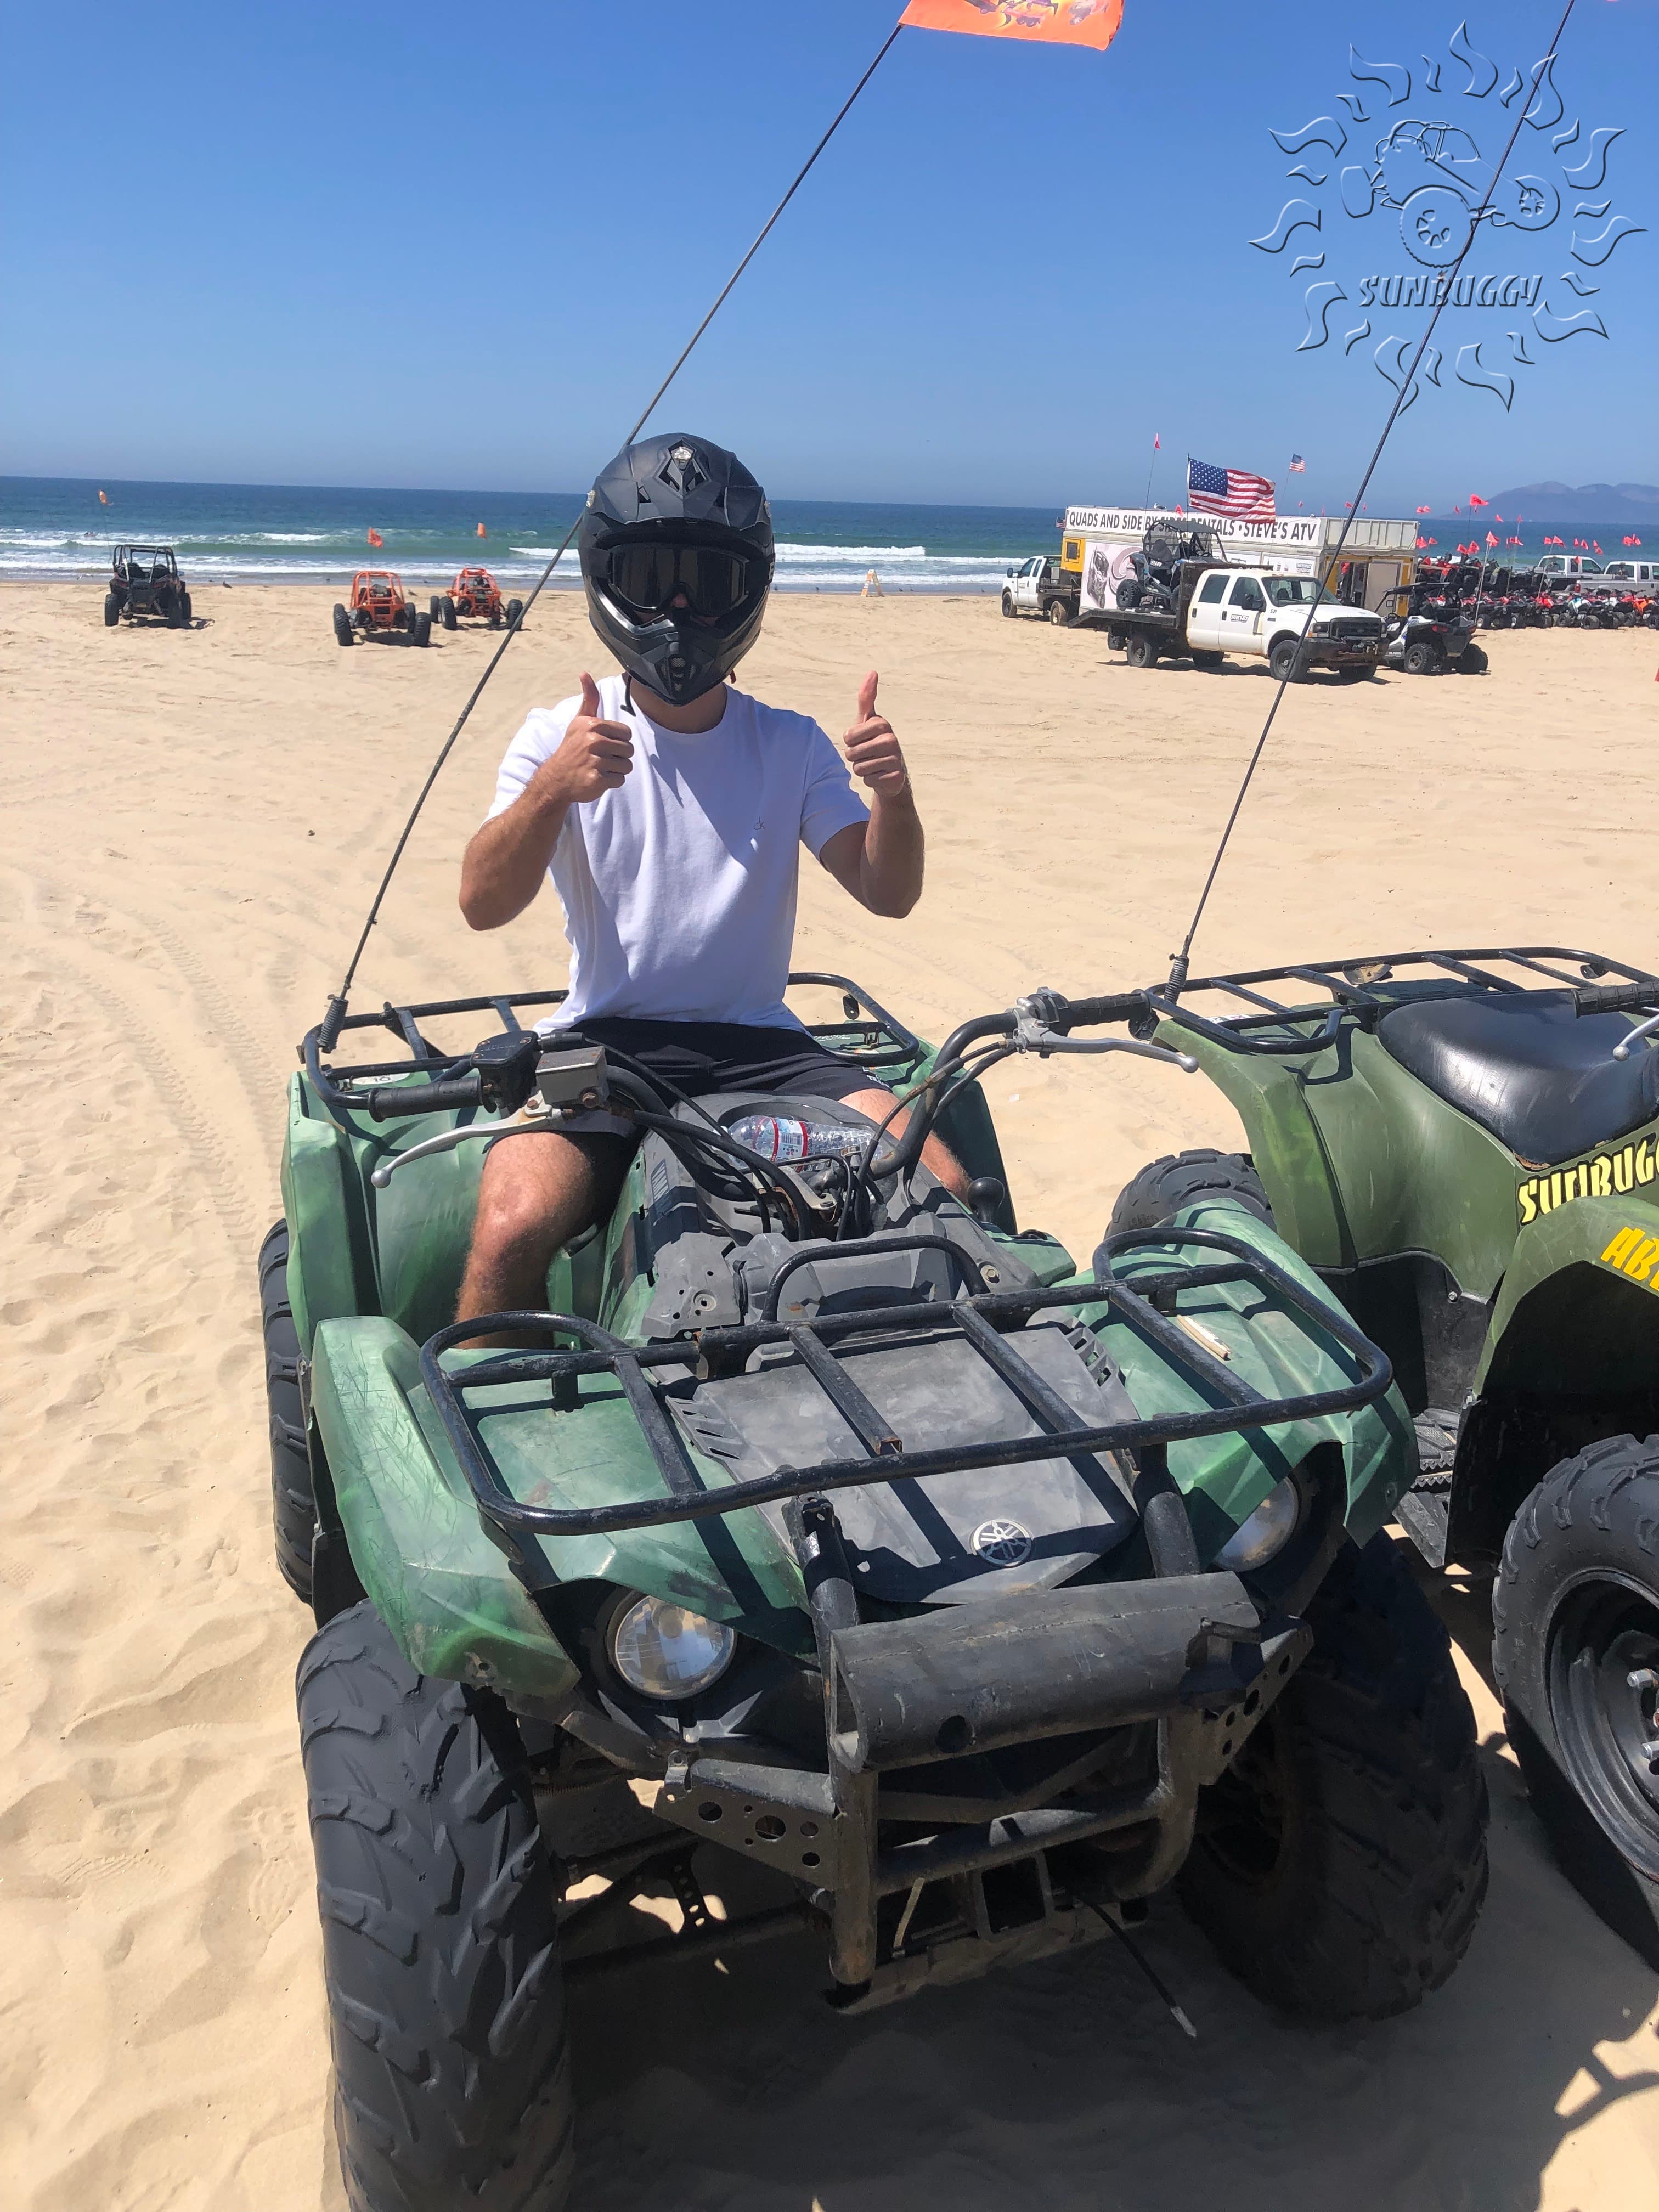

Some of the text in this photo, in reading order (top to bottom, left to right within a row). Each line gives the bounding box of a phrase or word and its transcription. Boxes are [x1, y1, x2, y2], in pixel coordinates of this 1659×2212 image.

[1070, 511, 1099, 527] QUADS
[1100, 514, 1119, 528] AND
[1121, 515, 1143, 530] SIDE
[1145, 516, 1159, 531] BY
[1243, 521, 1288, 539] STEVE'S
[1290, 523, 1317, 541] ATV
[1517, 1133, 1659, 1226] SUNBUG
[1600, 1226, 1659, 1291] AB
